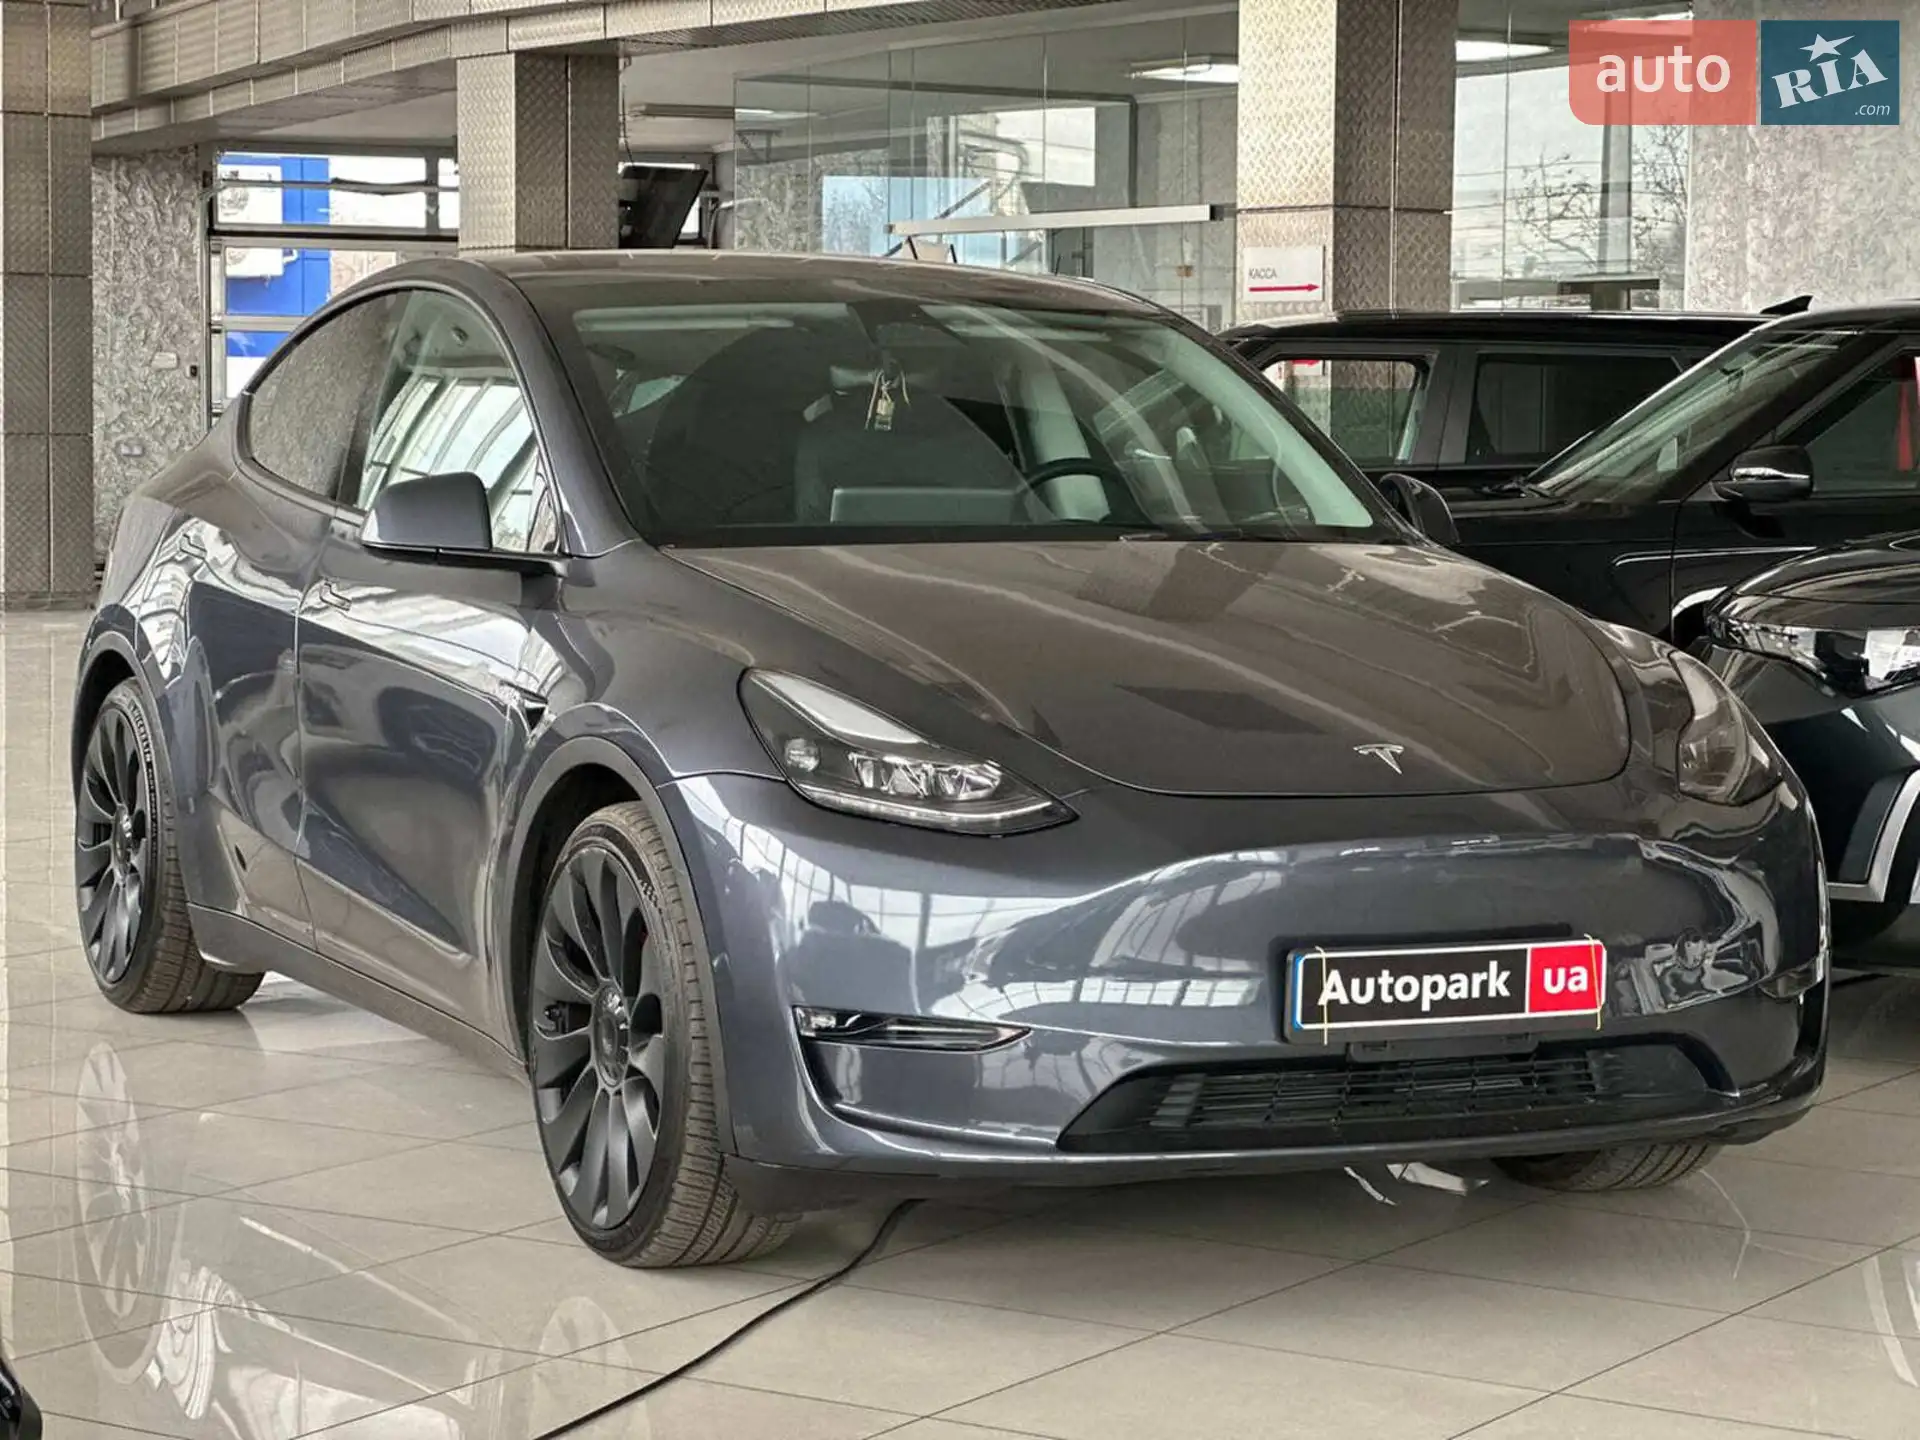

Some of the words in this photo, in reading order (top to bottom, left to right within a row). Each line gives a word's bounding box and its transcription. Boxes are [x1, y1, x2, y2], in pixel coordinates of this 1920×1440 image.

[1248, 267, 1278, 280] КАССА
[1317, 960, 1511, 1012] Autopark
[1543, 964, 1588, 994] ua
